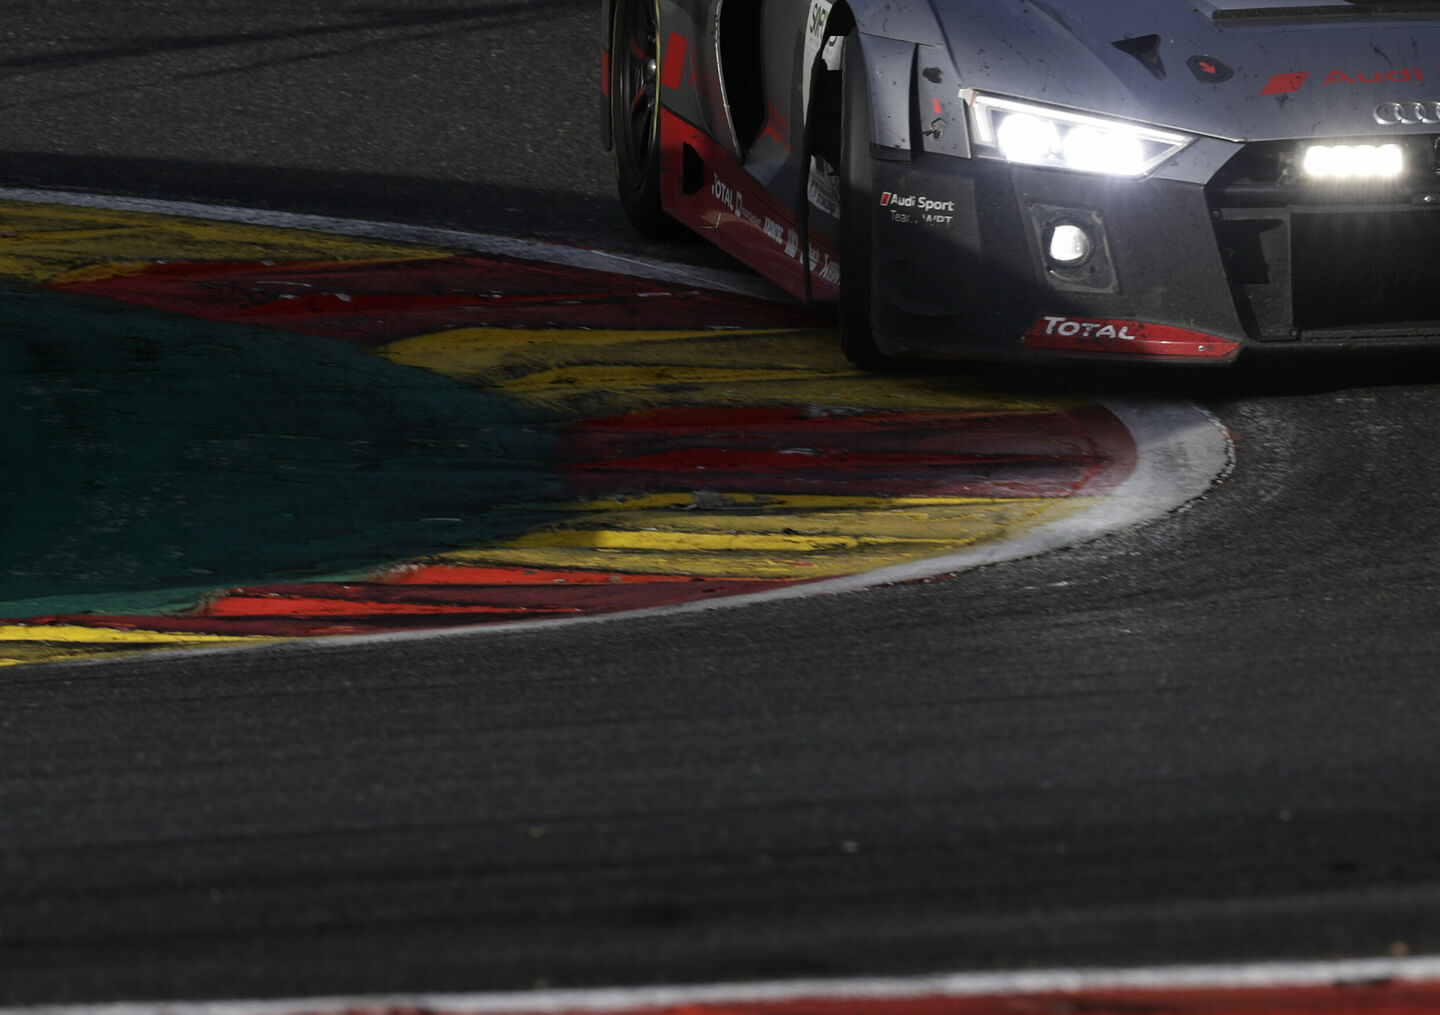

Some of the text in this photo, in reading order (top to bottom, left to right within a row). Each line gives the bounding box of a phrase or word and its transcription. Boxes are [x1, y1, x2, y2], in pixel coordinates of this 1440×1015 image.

[1323, 66, 1423, 85] Audi
[712, 171, 733, 210] TOTAL
[889, 193, 955, 211] Audi Sport
[1043, 315, 1137, 341] TOTAL
